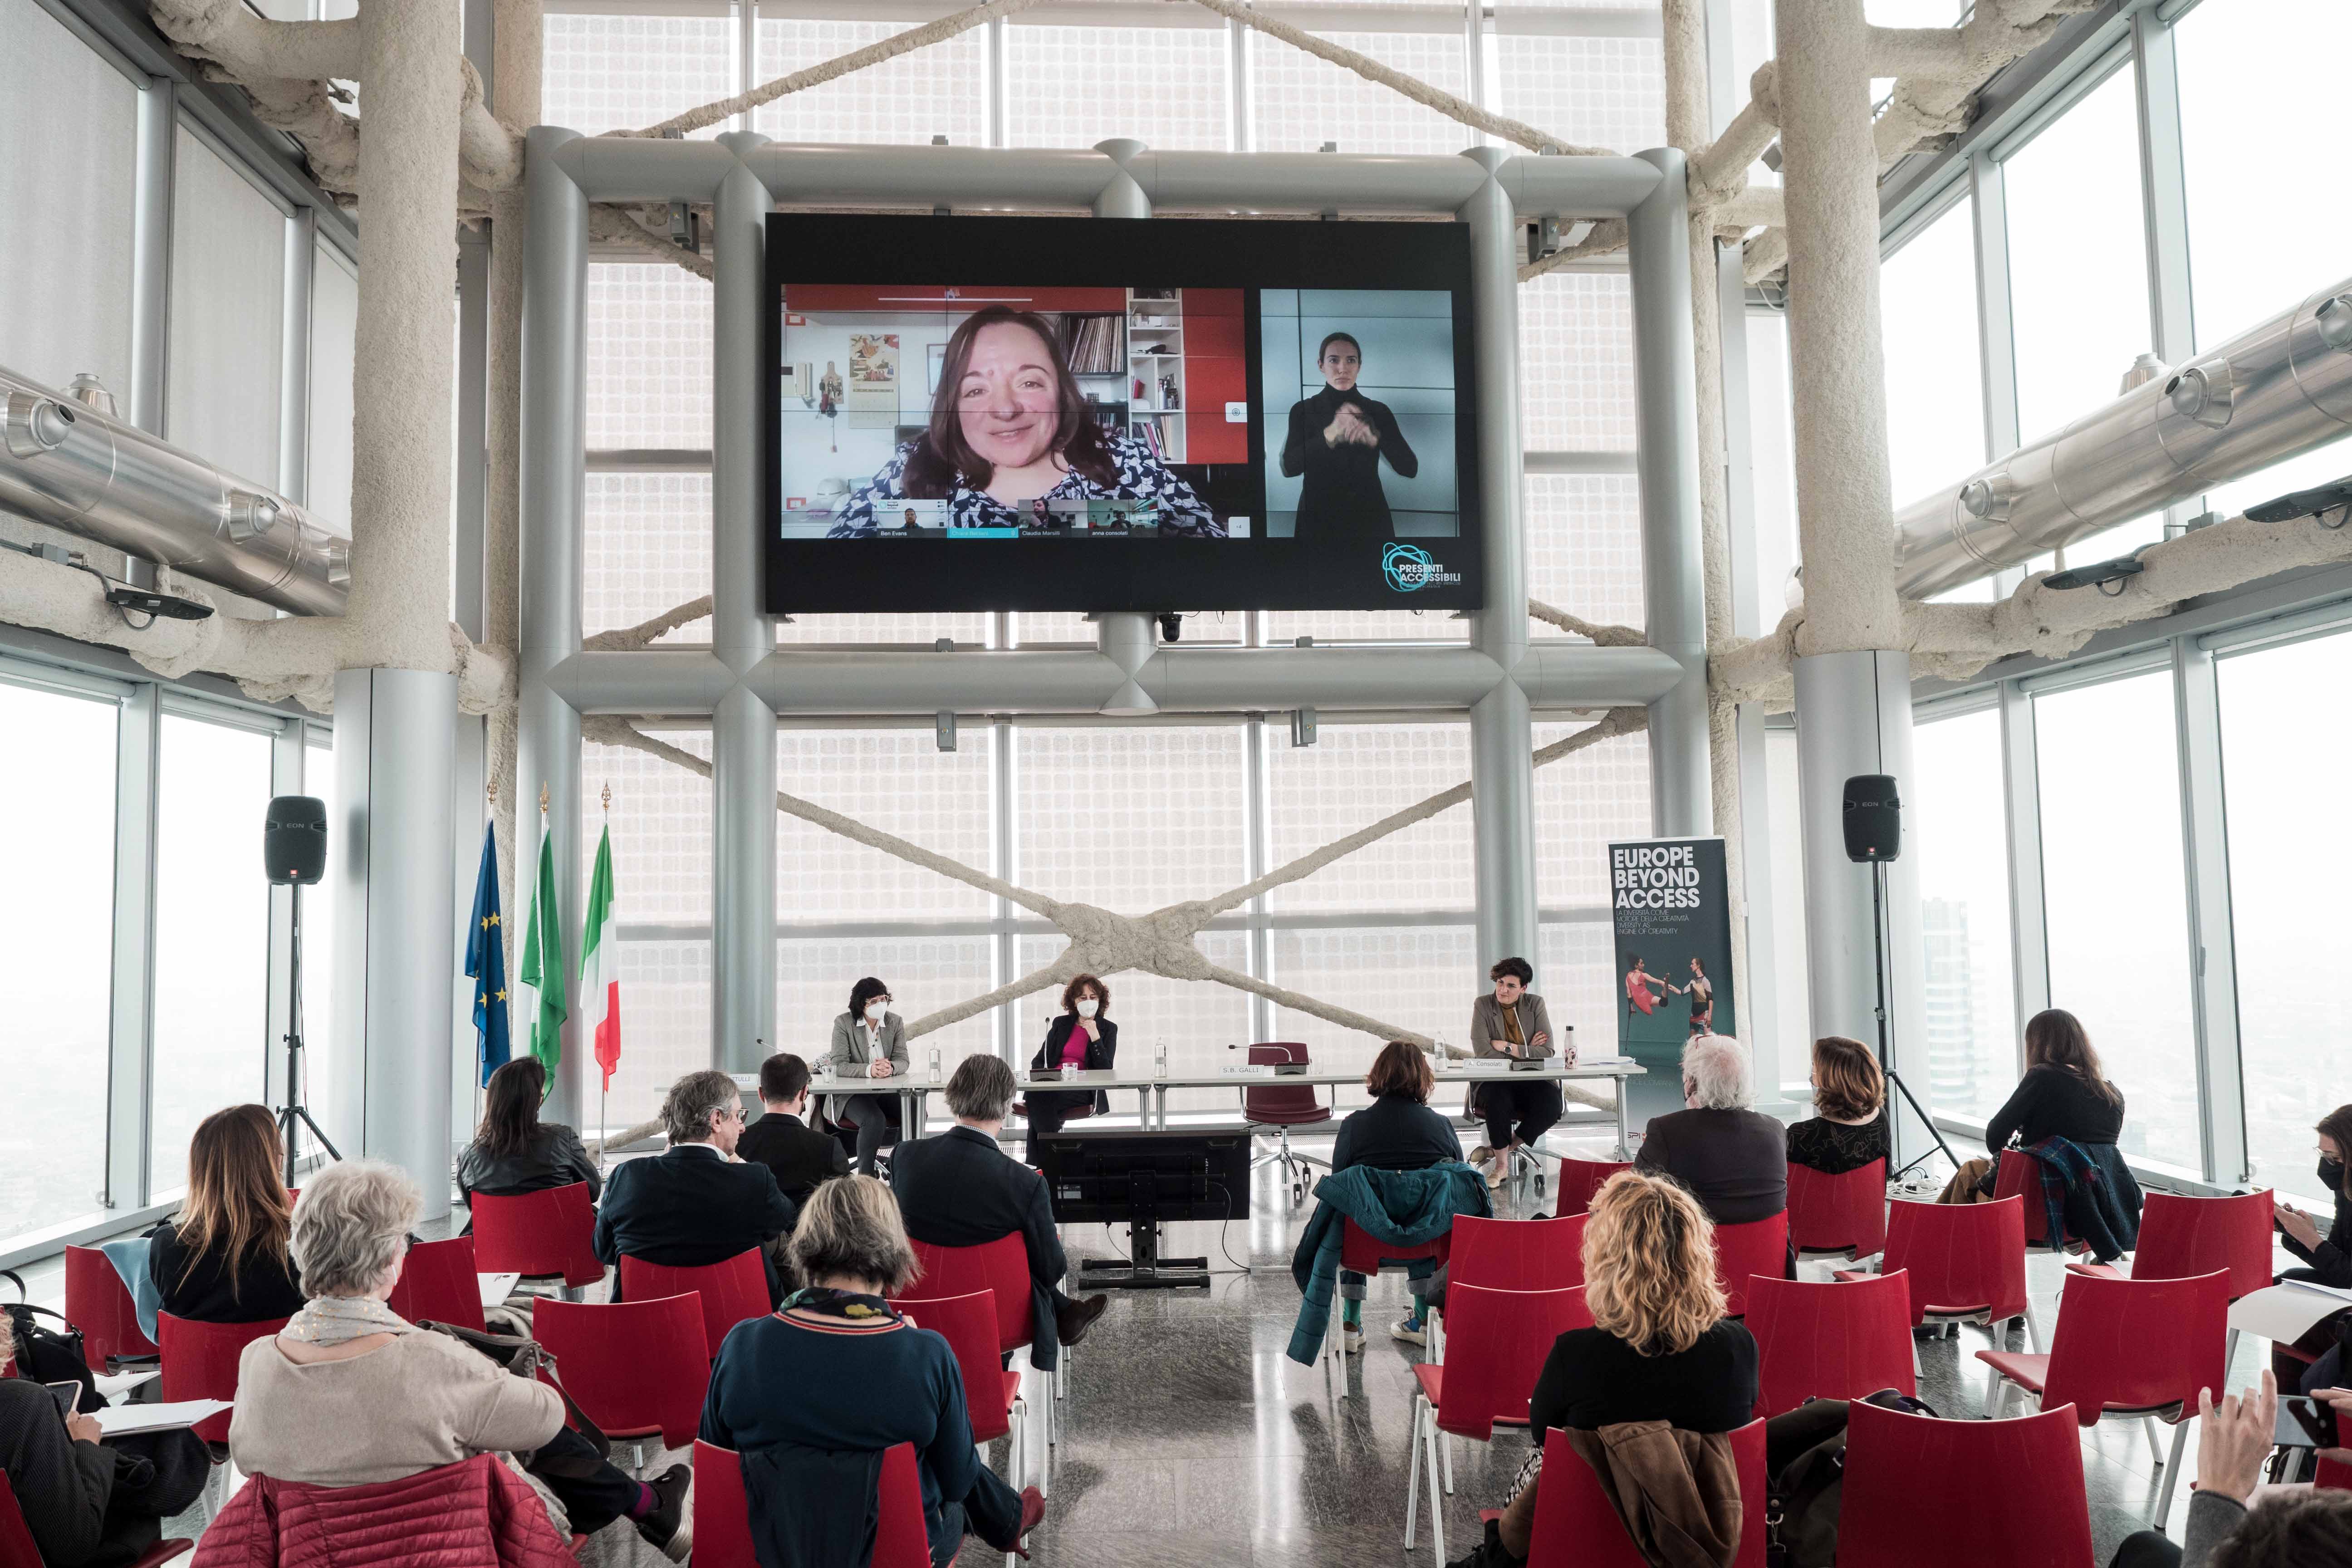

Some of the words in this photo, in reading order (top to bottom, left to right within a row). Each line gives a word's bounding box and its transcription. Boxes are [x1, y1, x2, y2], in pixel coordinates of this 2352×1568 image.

[1399, 564, 1443, 573] PRESENTI
[1400, 573, 1460, 582] ACCESSIBILI
[1614, 846, 1694, 868] EUROPE
[1615, 867, 1700, 888] BEYOND
[1616, 888, 1700, 908] ACCESS
